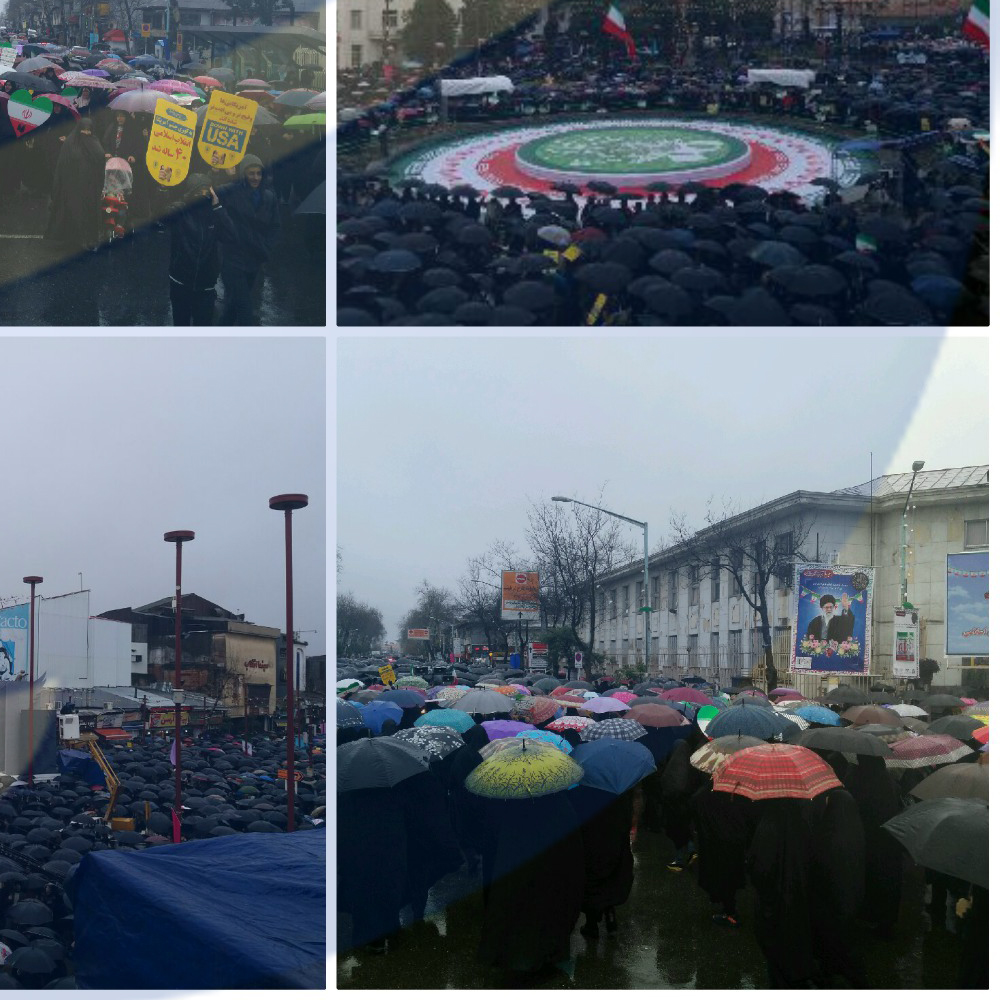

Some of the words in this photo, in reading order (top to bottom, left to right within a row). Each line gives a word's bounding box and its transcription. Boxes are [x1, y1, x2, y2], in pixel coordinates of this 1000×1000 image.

[153, 129, 175, 143] اسلامی
[173, 136, 191, 147] انقلاب
[206, 126, 240, 150] USA
